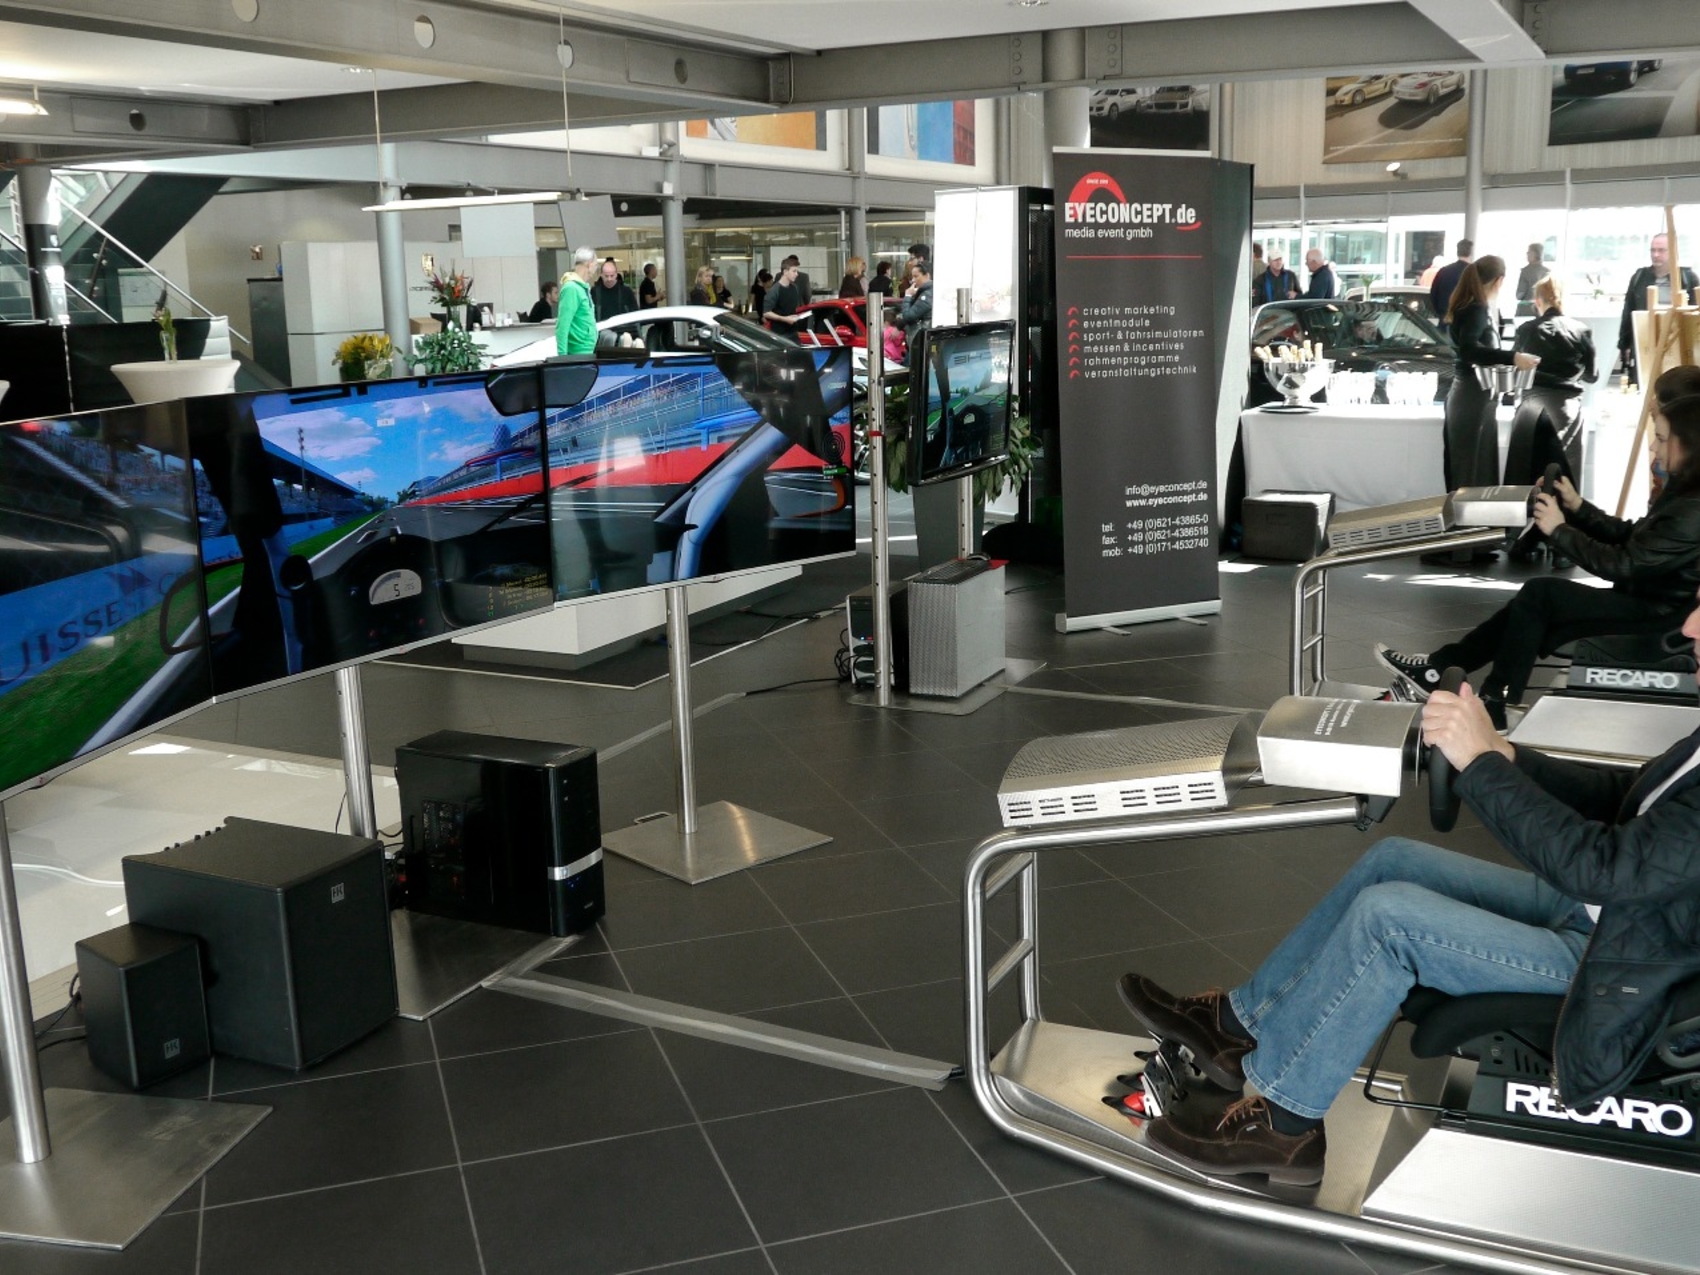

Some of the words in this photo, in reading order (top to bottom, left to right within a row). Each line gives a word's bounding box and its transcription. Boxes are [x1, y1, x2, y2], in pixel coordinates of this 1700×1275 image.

[1064, 202, 1197, 224] EYECONCEPT.de
[1064, 227, 1095, 238] media
[1097, 228, 1124, 238] event
[1126, 227, 1153, 240] gmbh
[1083, 306, 1121, 316] creativ
[1124, 305, 1176, 316] marketing
[1083, 318, 1150, 328] eventmodule
[1083, 331, 1114, 342] sport-
[1116, 330, 1123, 340] &
[1125, 329, 1205, 340] fahrsimulatoren
[1083, 344, 1121, 353] messen
[1123, 342, 1130, 352] &
[1132, 341, 1185, 352] incentives
[1084, 354, 1180, 366] rahmenprogramme
[1085, 365, 1197, 379] veranstaltungstechnik
[1125, 480, 1208, 496] info@eyeconcept.de
[1125, 492, 1208, 507] www.eyeconcept.de
[1126, 519, 1143, 530] +49
[1102, 535, 1118, 545] fax:
[1127, 532, 1143, 542] +49
[1102, 547, 1123, 557] mob:
[1127, 544, 1144, 554] +49
[1585, 667, 1680, 689] RECARO
